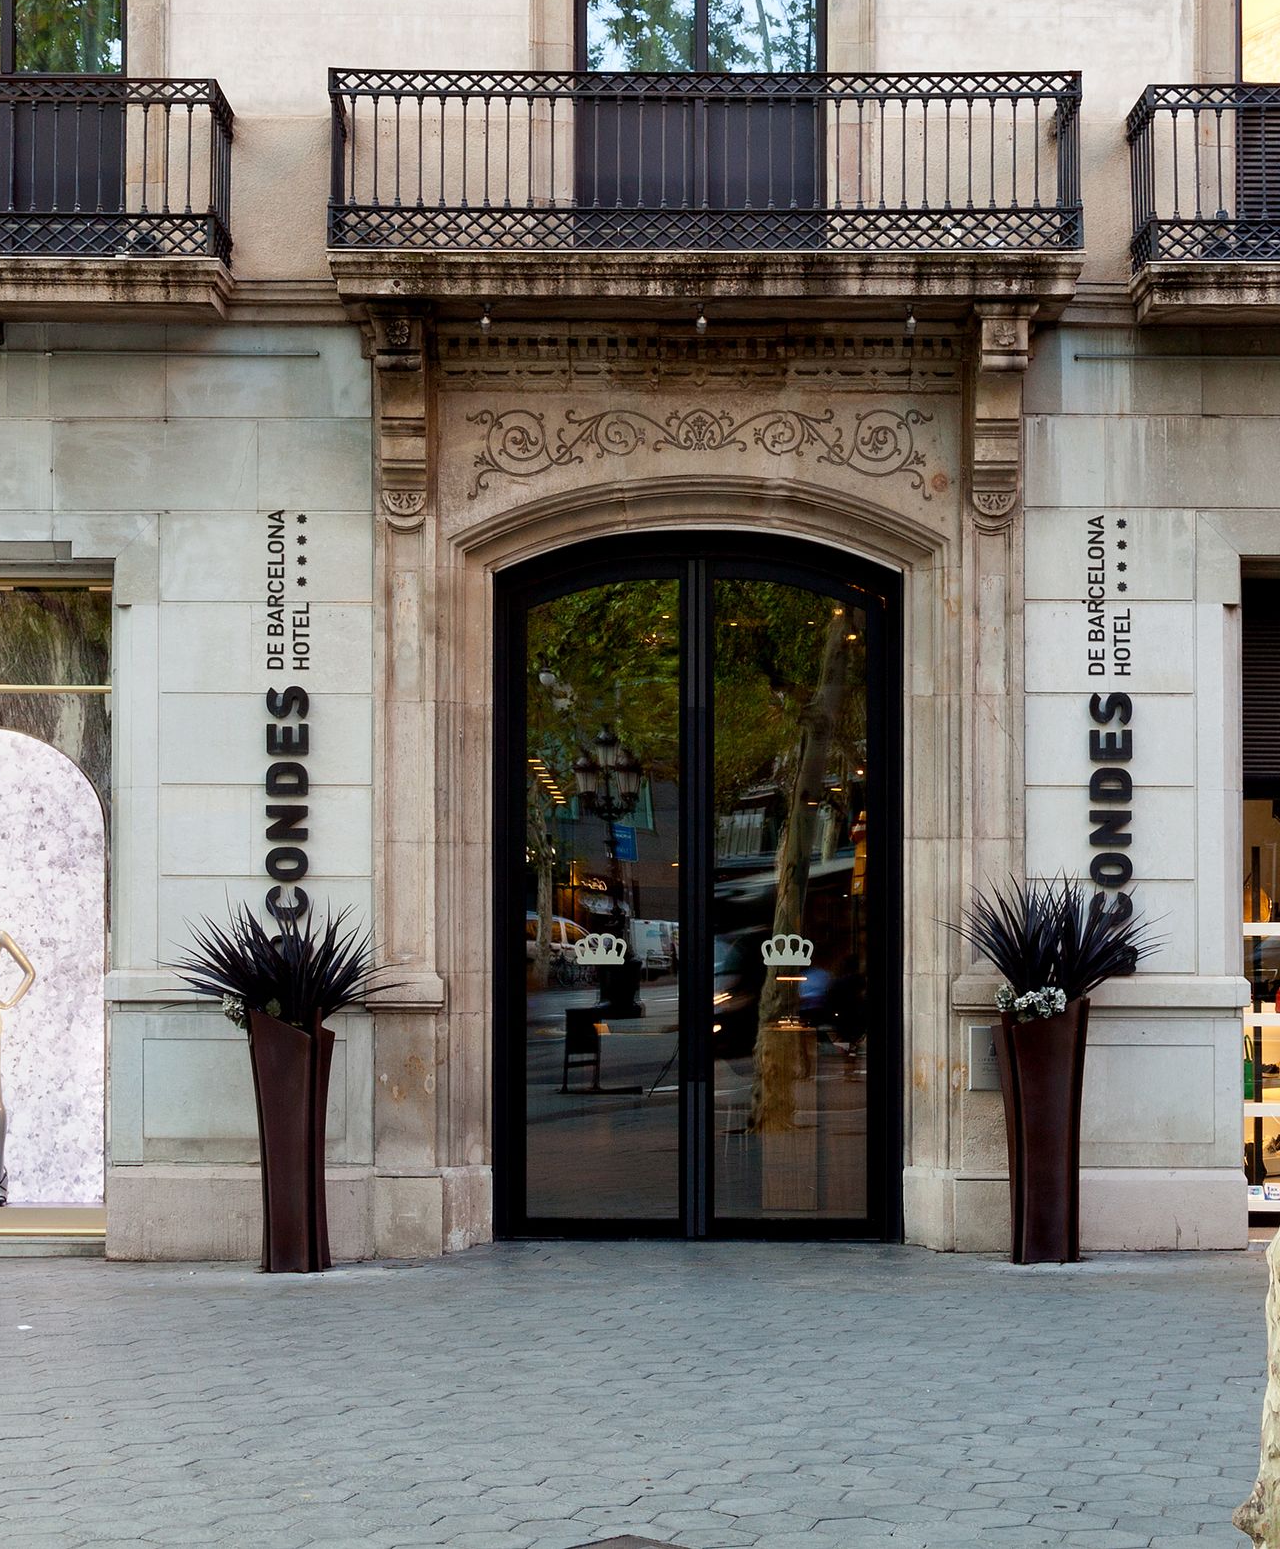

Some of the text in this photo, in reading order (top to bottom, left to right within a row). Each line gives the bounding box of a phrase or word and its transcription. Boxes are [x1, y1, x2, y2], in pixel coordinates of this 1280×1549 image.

[266, 509, 286, 670] DE BARCELONA
[292, 602, 310, 670] HOTEL
[1087, 514, 1106, 676] DE BARCELONA
[1113, 608, 1132, 676] HOTEL
[265, 685, 310, 922] CONDES
[1089, 691, 1134, 927] CONDES
